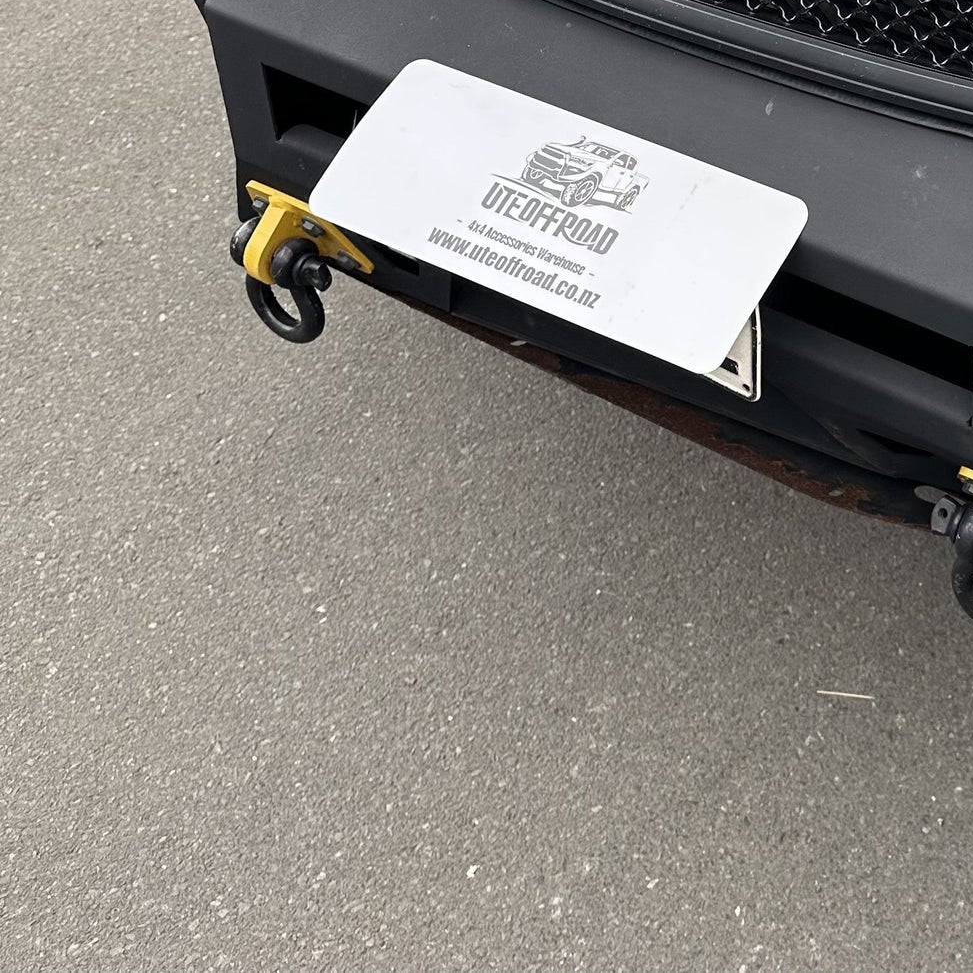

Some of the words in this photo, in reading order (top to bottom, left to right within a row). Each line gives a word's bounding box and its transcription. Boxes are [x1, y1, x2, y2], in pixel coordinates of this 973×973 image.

[468, 220, 488, 237] 4x4
[485, 228, 537, 257] Accessories
[537, 247, 586, 276] Warehouse
[481, 182, 619, 255] UTEOFFROAD
[428, 228, 602, 309] www.uteoffroad.co.nz
